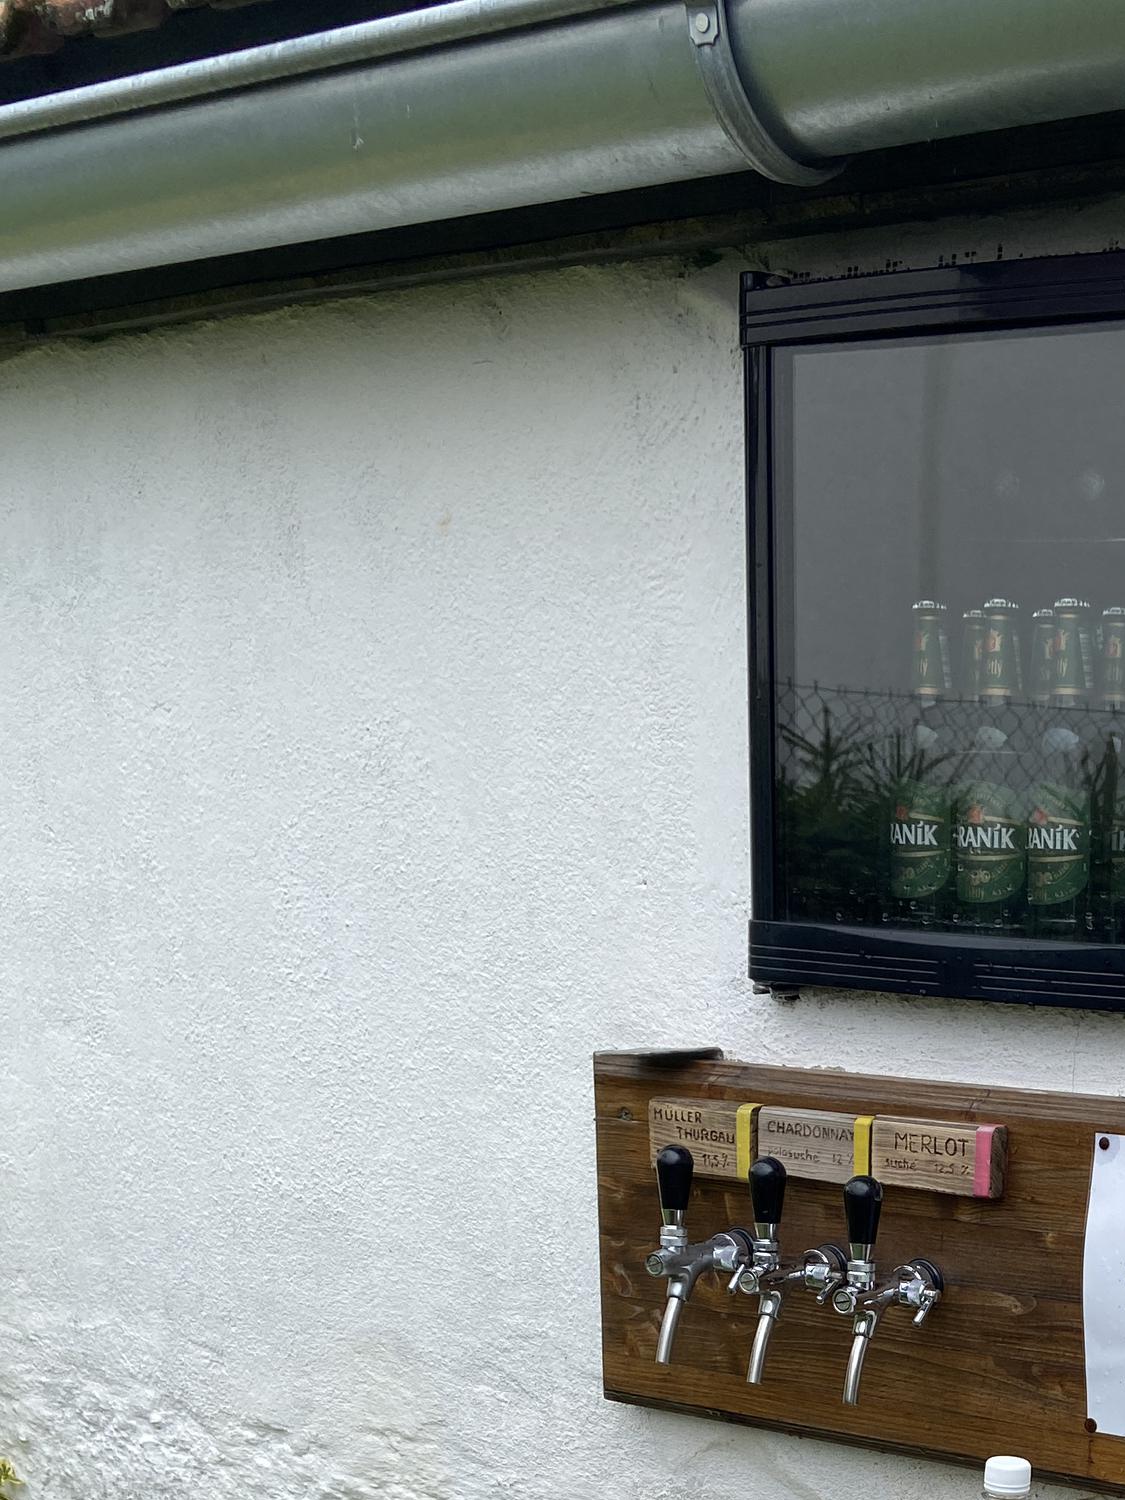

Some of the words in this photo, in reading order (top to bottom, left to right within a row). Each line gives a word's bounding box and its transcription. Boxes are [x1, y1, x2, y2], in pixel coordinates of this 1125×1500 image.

[653, 1104, 703, 1124] MÜLLER
[676, 1125, 735, 1144] THURGAU
[767, 1120, 855, 1142] CHARDONNAY
[894, 1132, 970, 1157] MERLOT
